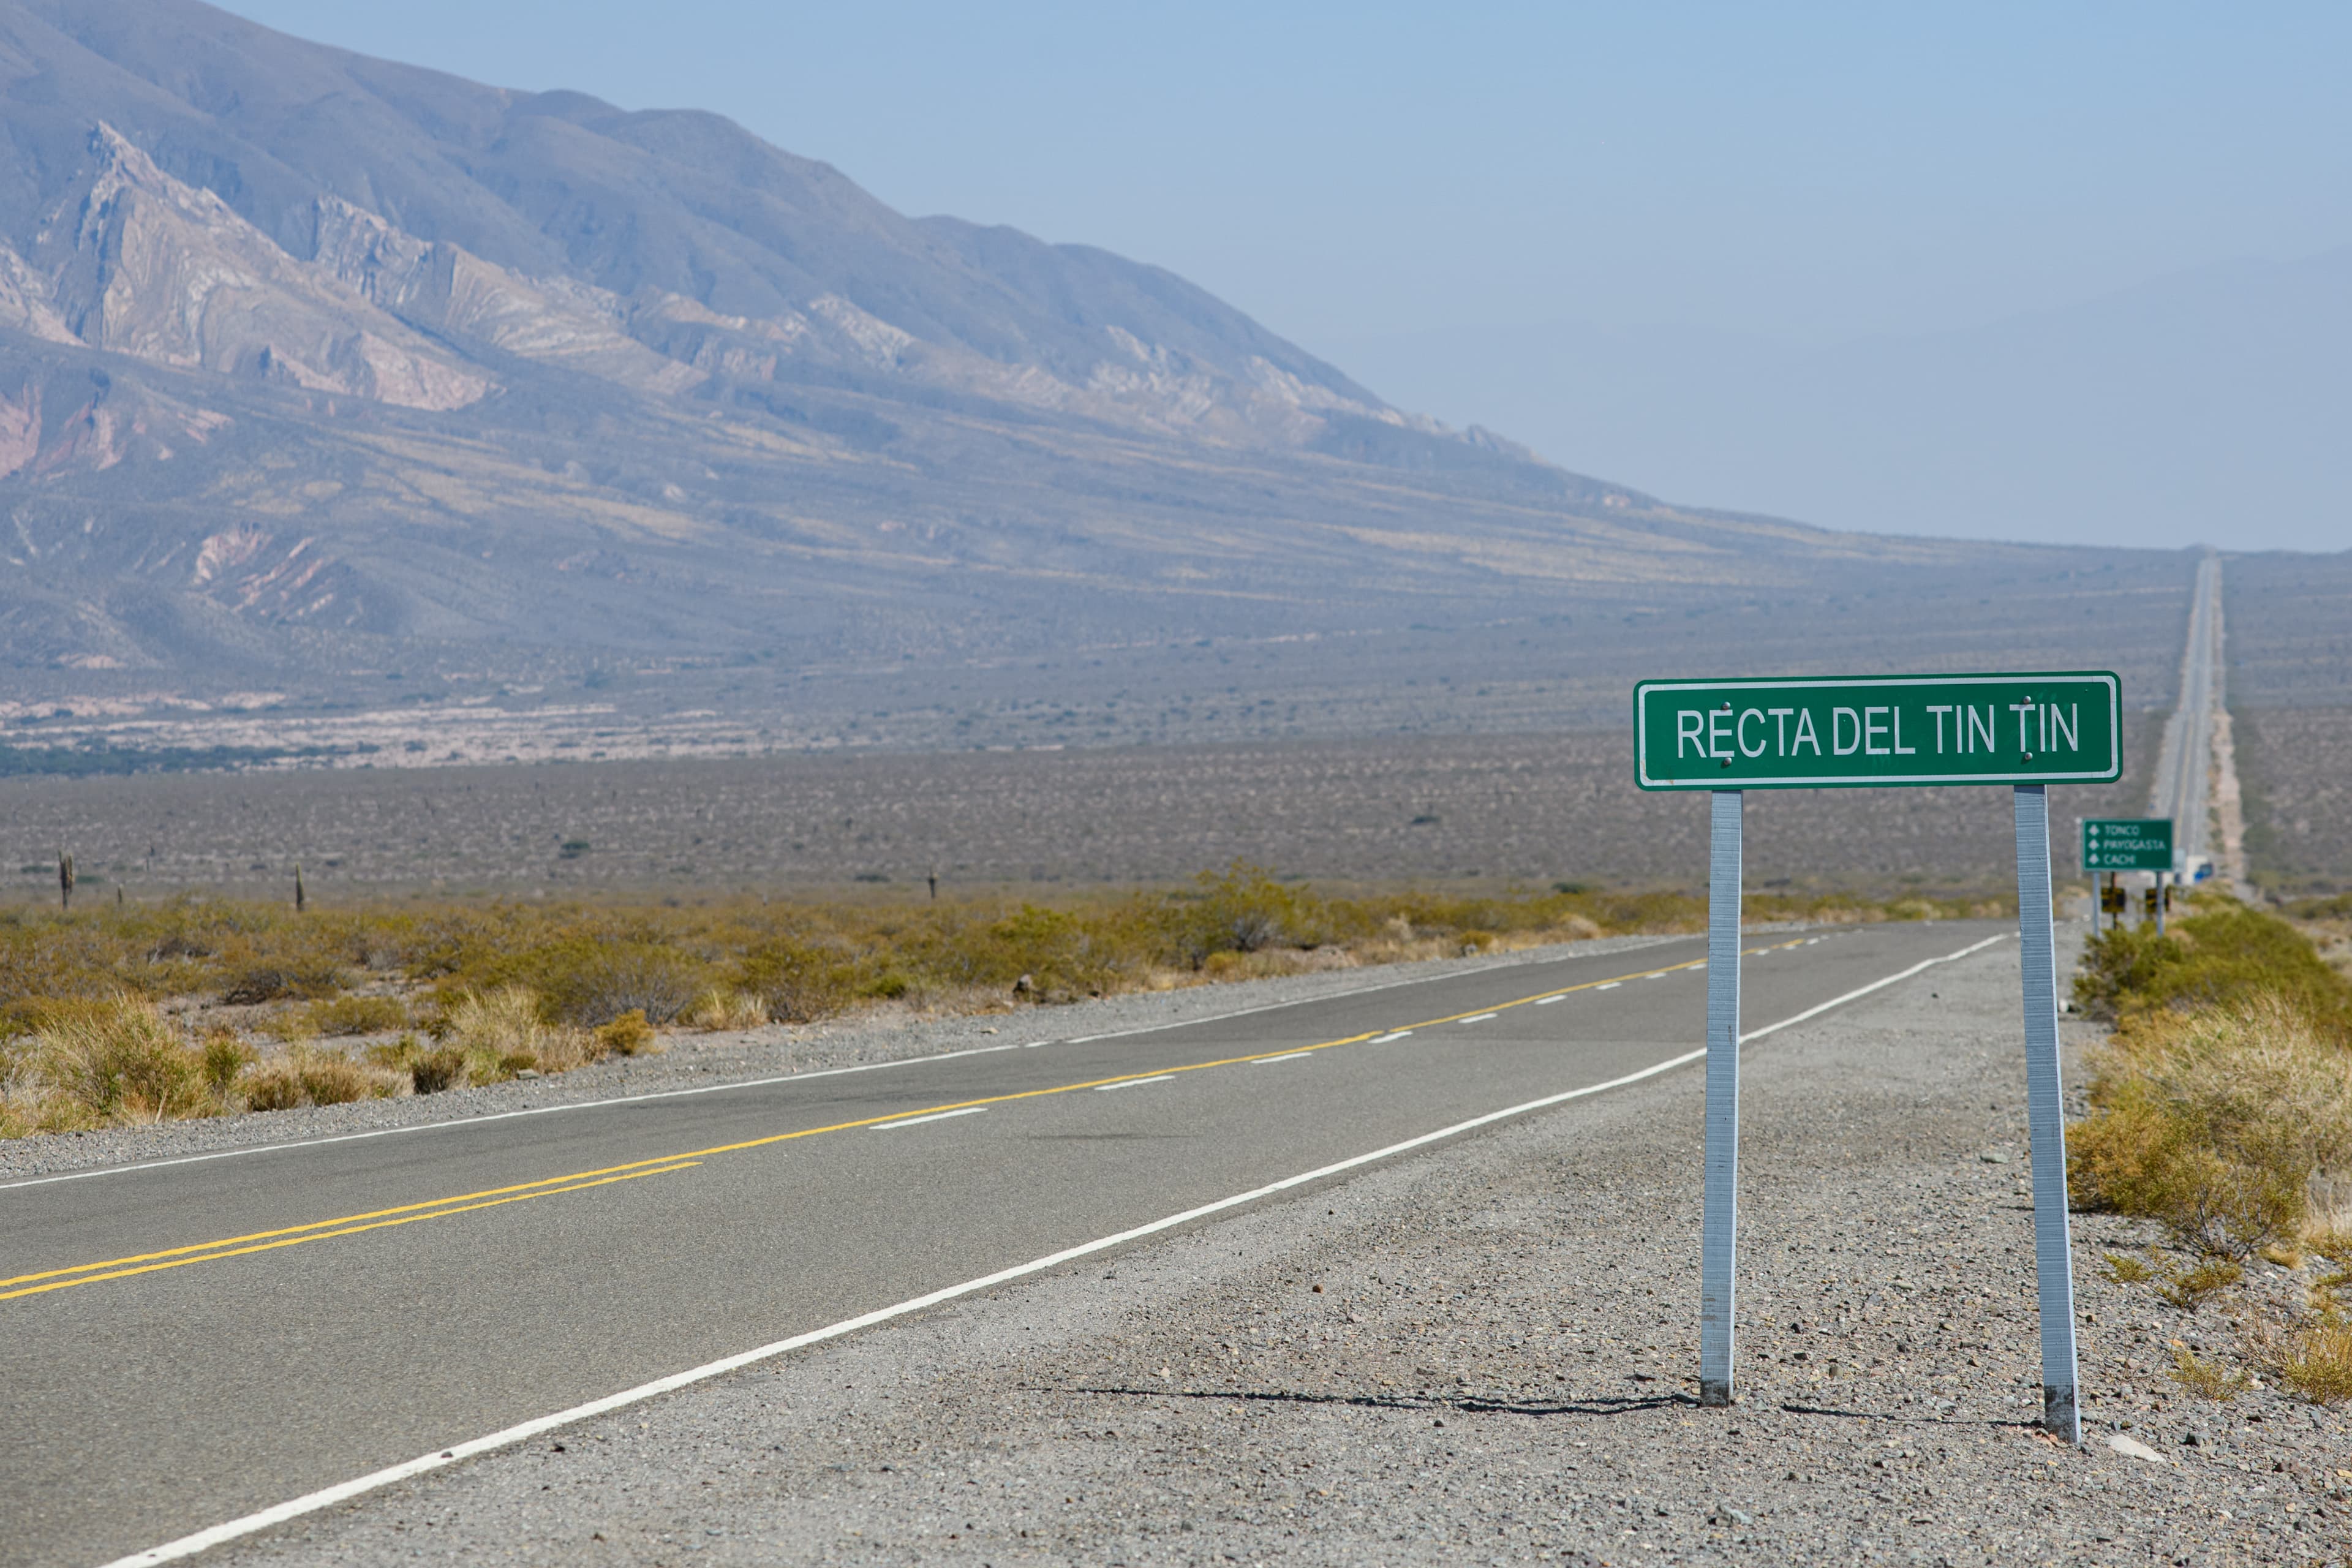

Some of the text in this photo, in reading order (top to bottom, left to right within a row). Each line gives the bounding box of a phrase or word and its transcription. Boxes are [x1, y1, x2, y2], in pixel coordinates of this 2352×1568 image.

[1677, 703, 2078, 758] RECTA DEL TIN TIN
[2105, 825, 2139, 835] TONCO
[2103, 839, 2166, 850] PAYOGASTA
[2103, 854, 2136, 864] CACHI
